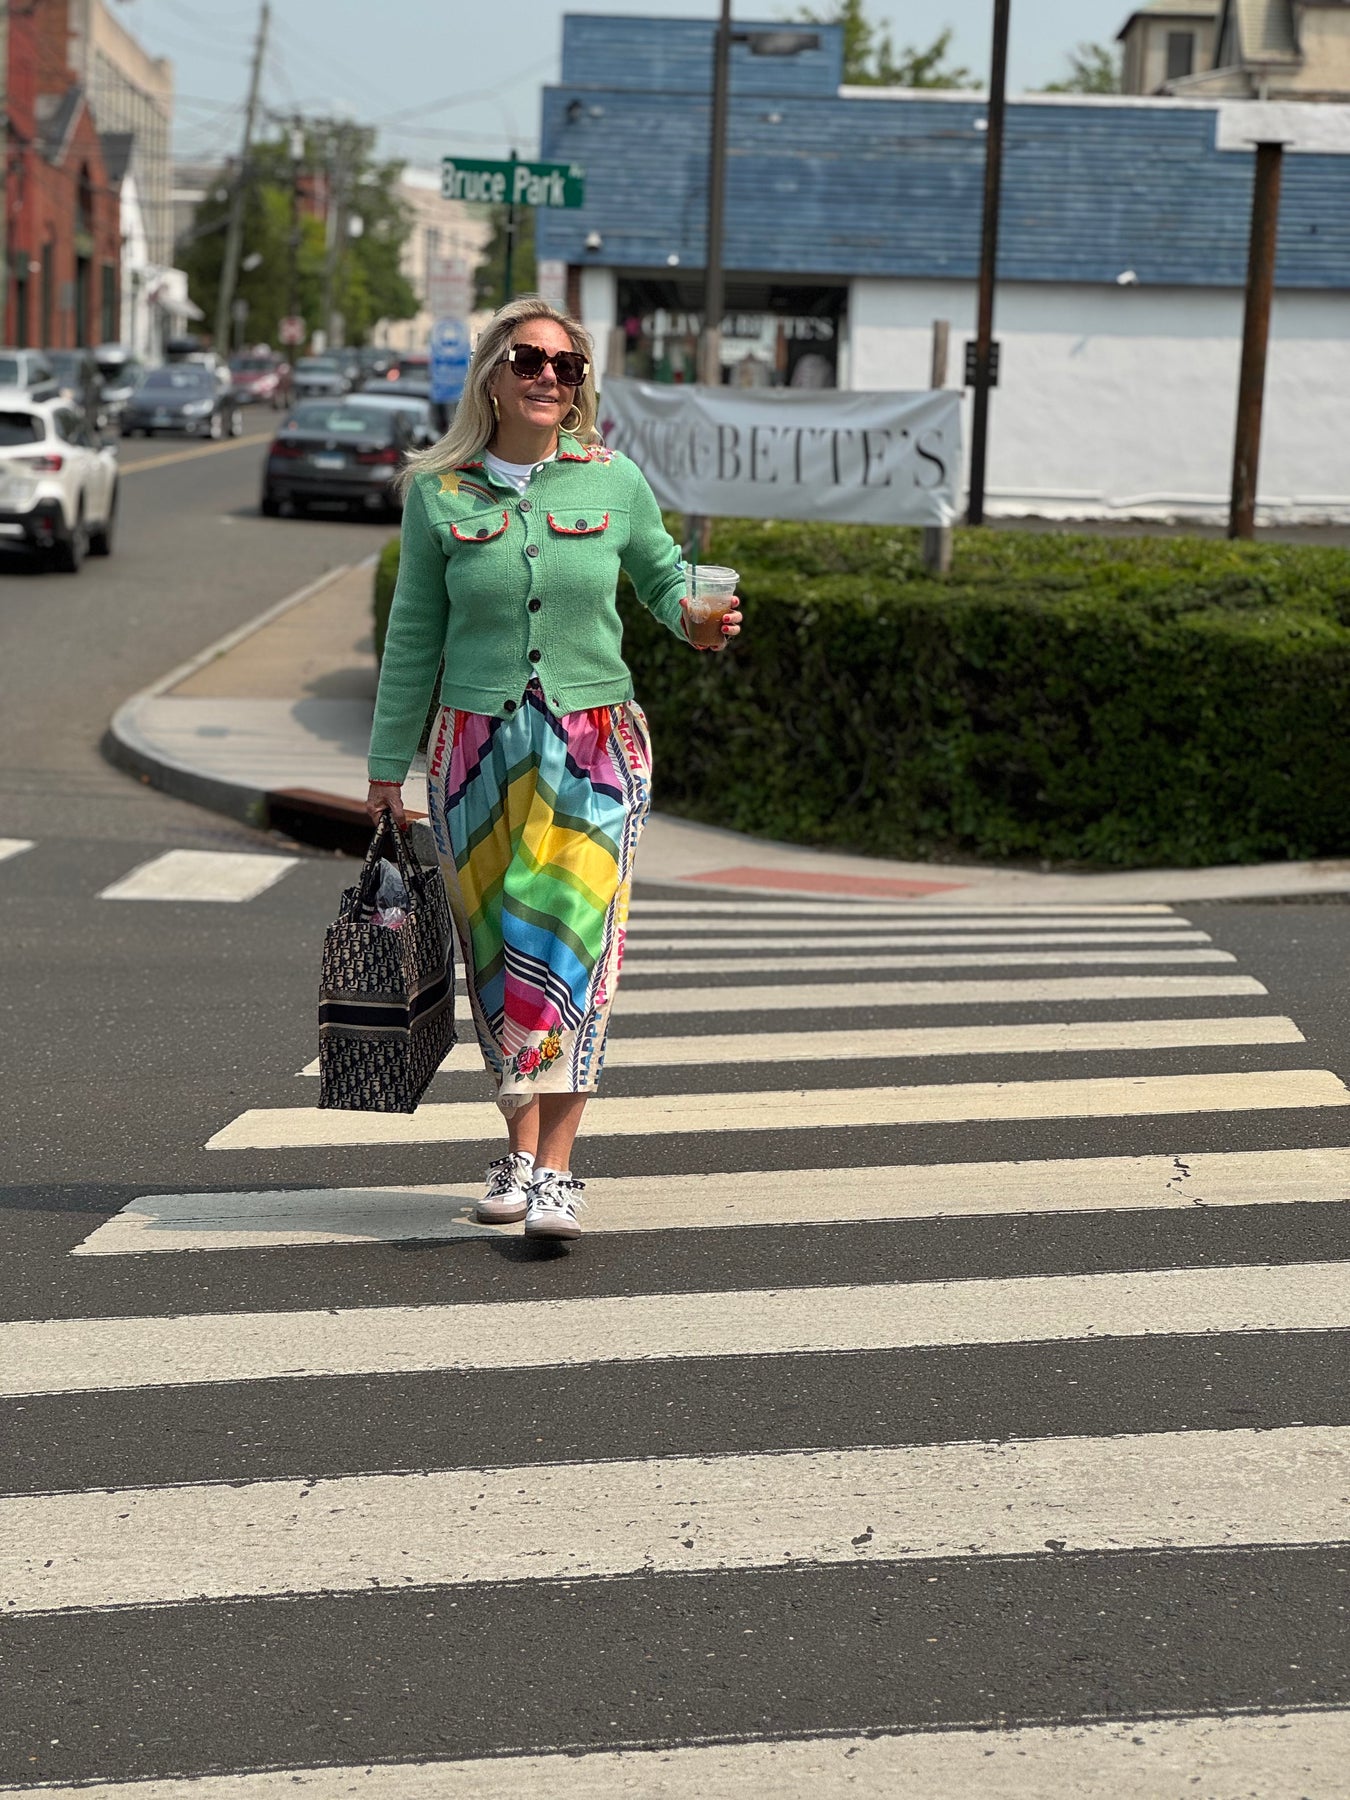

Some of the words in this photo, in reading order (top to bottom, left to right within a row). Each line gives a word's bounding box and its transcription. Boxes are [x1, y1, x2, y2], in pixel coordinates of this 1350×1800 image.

[441, 160, 506, 202] Bruce
[512, 166, 566, 207] Park
[714, 423, 948, 489] BETTE'S
[579, 1010, 602, 1086] HAPPY
